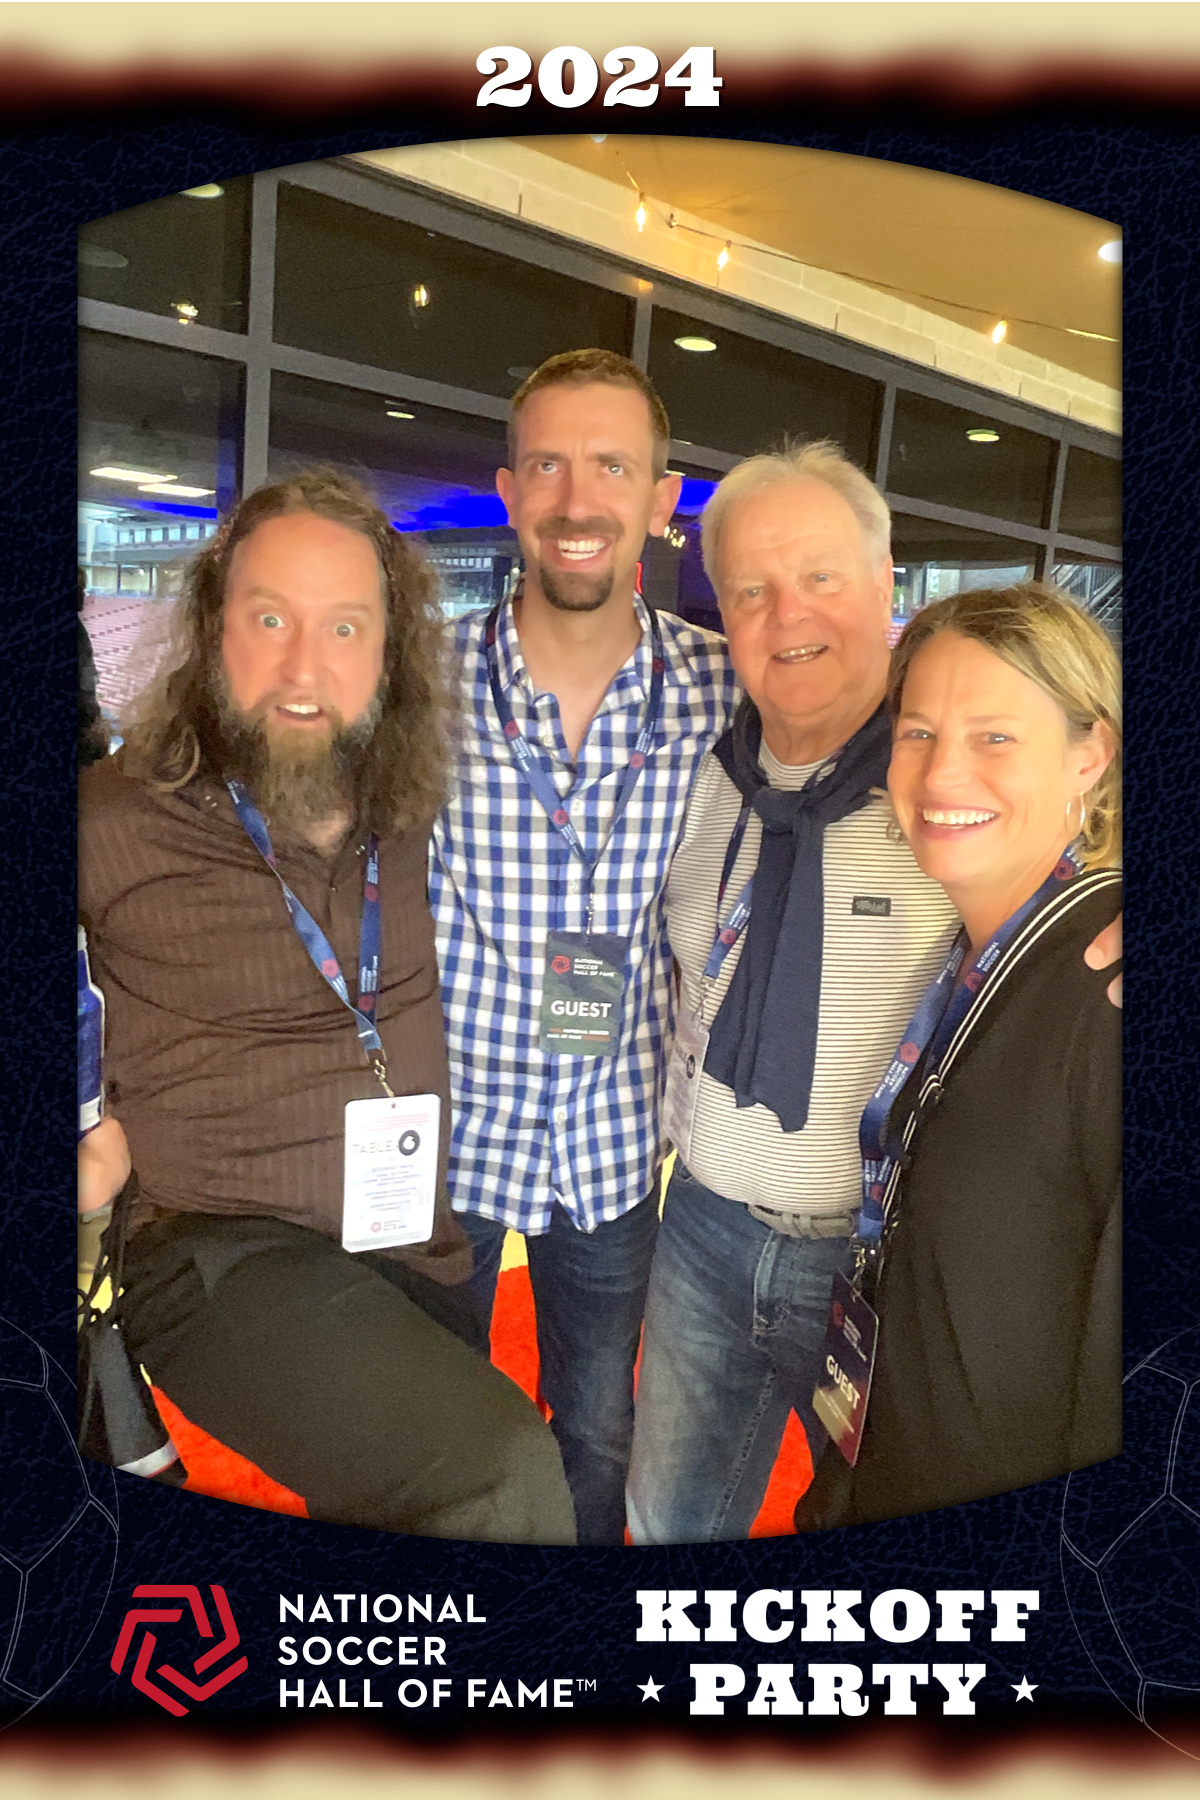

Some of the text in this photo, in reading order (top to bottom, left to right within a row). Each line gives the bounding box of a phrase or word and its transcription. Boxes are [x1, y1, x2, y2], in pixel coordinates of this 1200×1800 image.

[976, 941, 999, 968] NATIONAL
[550, 1000, 613, 1018] GUEST
[826, 1355, 861, 1410] GUEST
